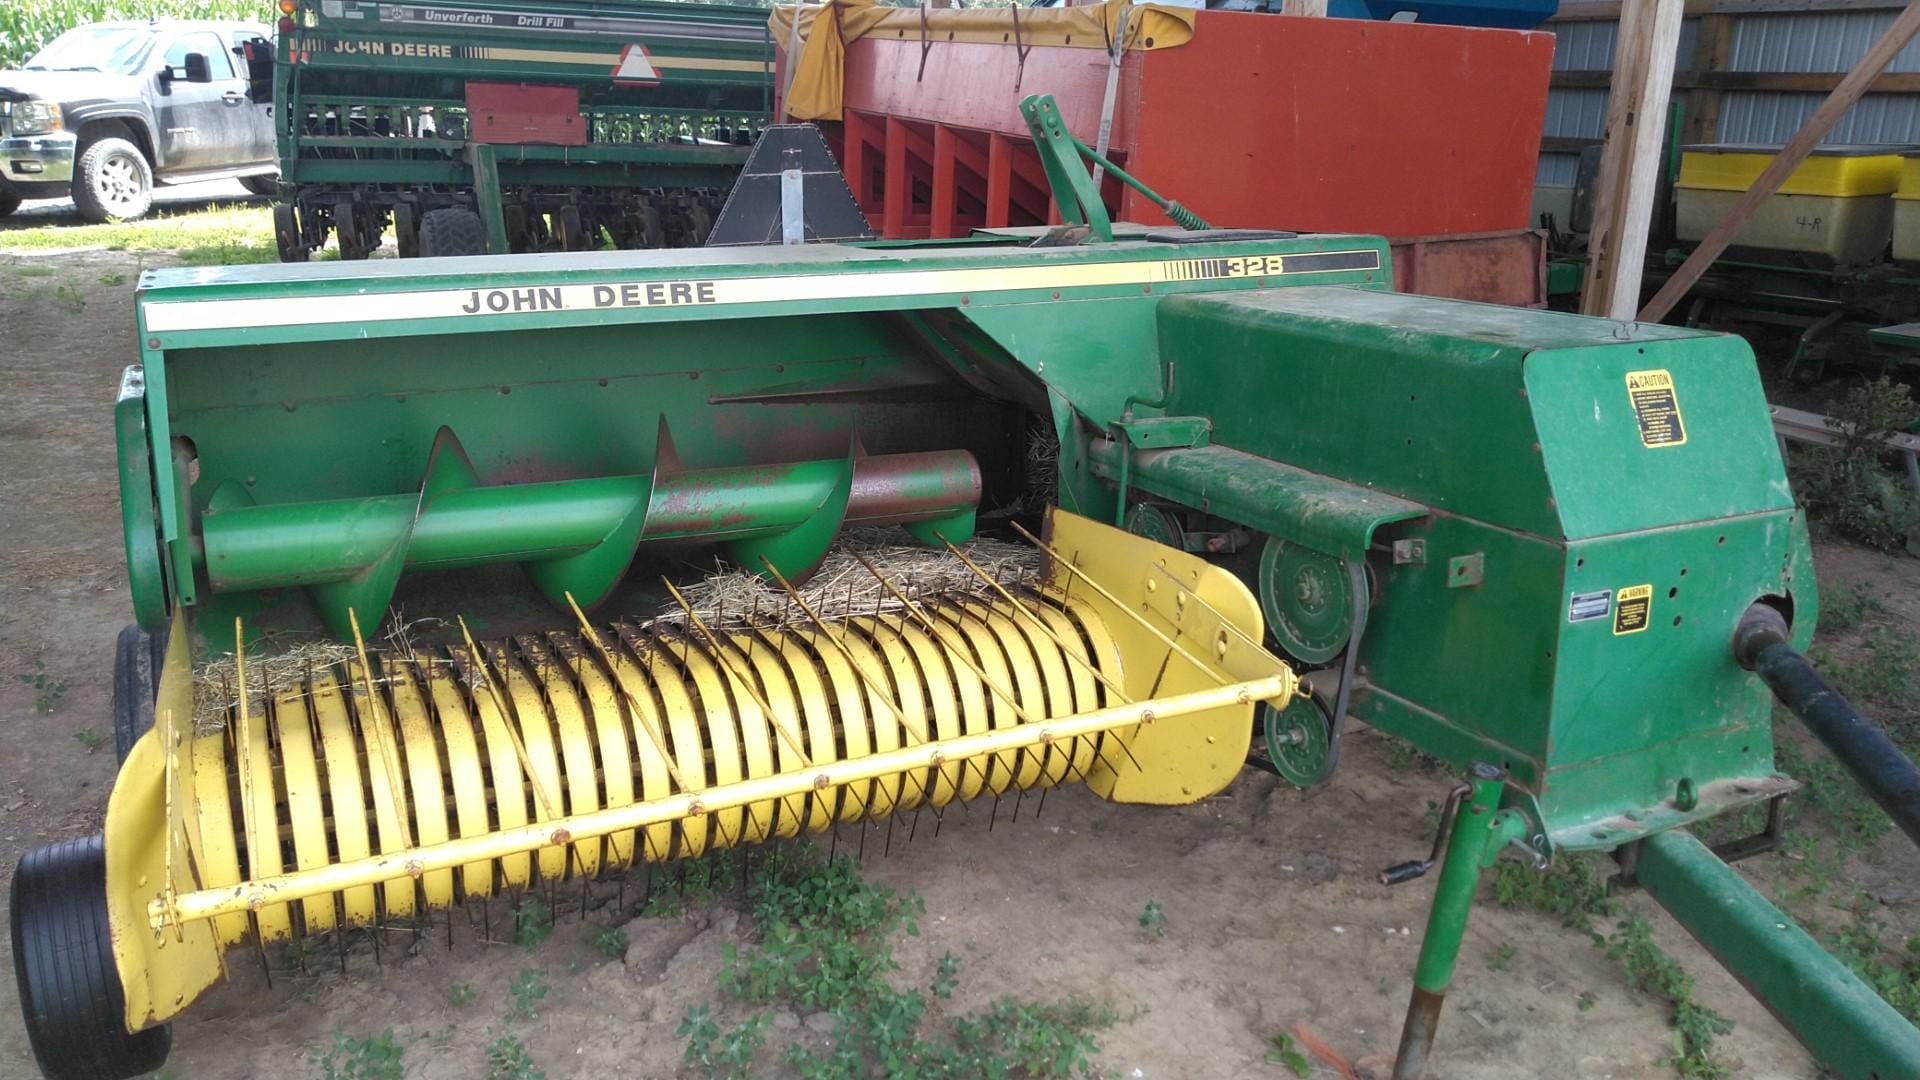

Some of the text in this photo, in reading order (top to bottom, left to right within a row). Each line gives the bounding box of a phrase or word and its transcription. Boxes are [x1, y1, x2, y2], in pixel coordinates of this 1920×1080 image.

[424, 9, 564, 28] Unverferth Drill Fill
[391, 42, 452, 58] DEERE
[1227, 256, 1284, 276] 328
[462, 282, 716, 314] JOHN DEERE
[1638, 374, 1670, 387] CAUTION
